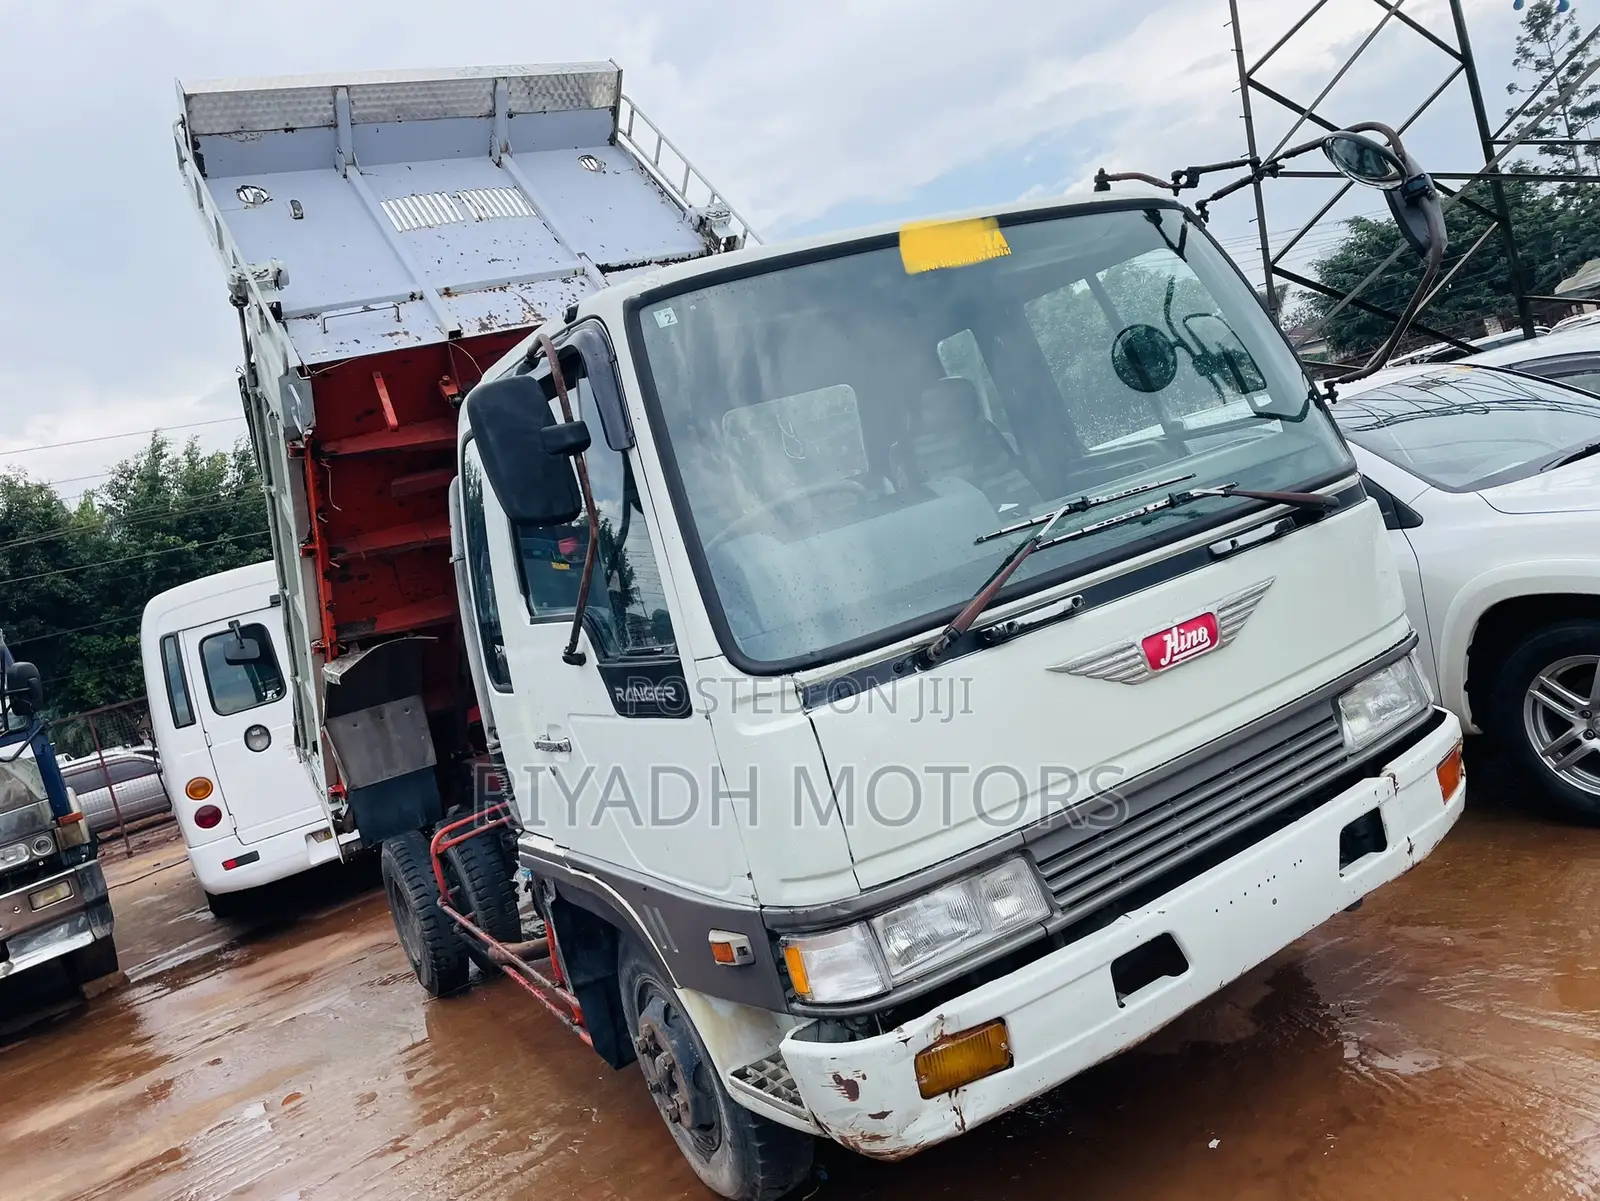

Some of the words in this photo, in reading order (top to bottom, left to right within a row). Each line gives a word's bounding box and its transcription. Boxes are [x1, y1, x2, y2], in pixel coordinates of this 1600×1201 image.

[664, 313, 674, 324] 2
[1160, 625, 1211, 666] Hino
[614, 686, 677, 702] RANGER
